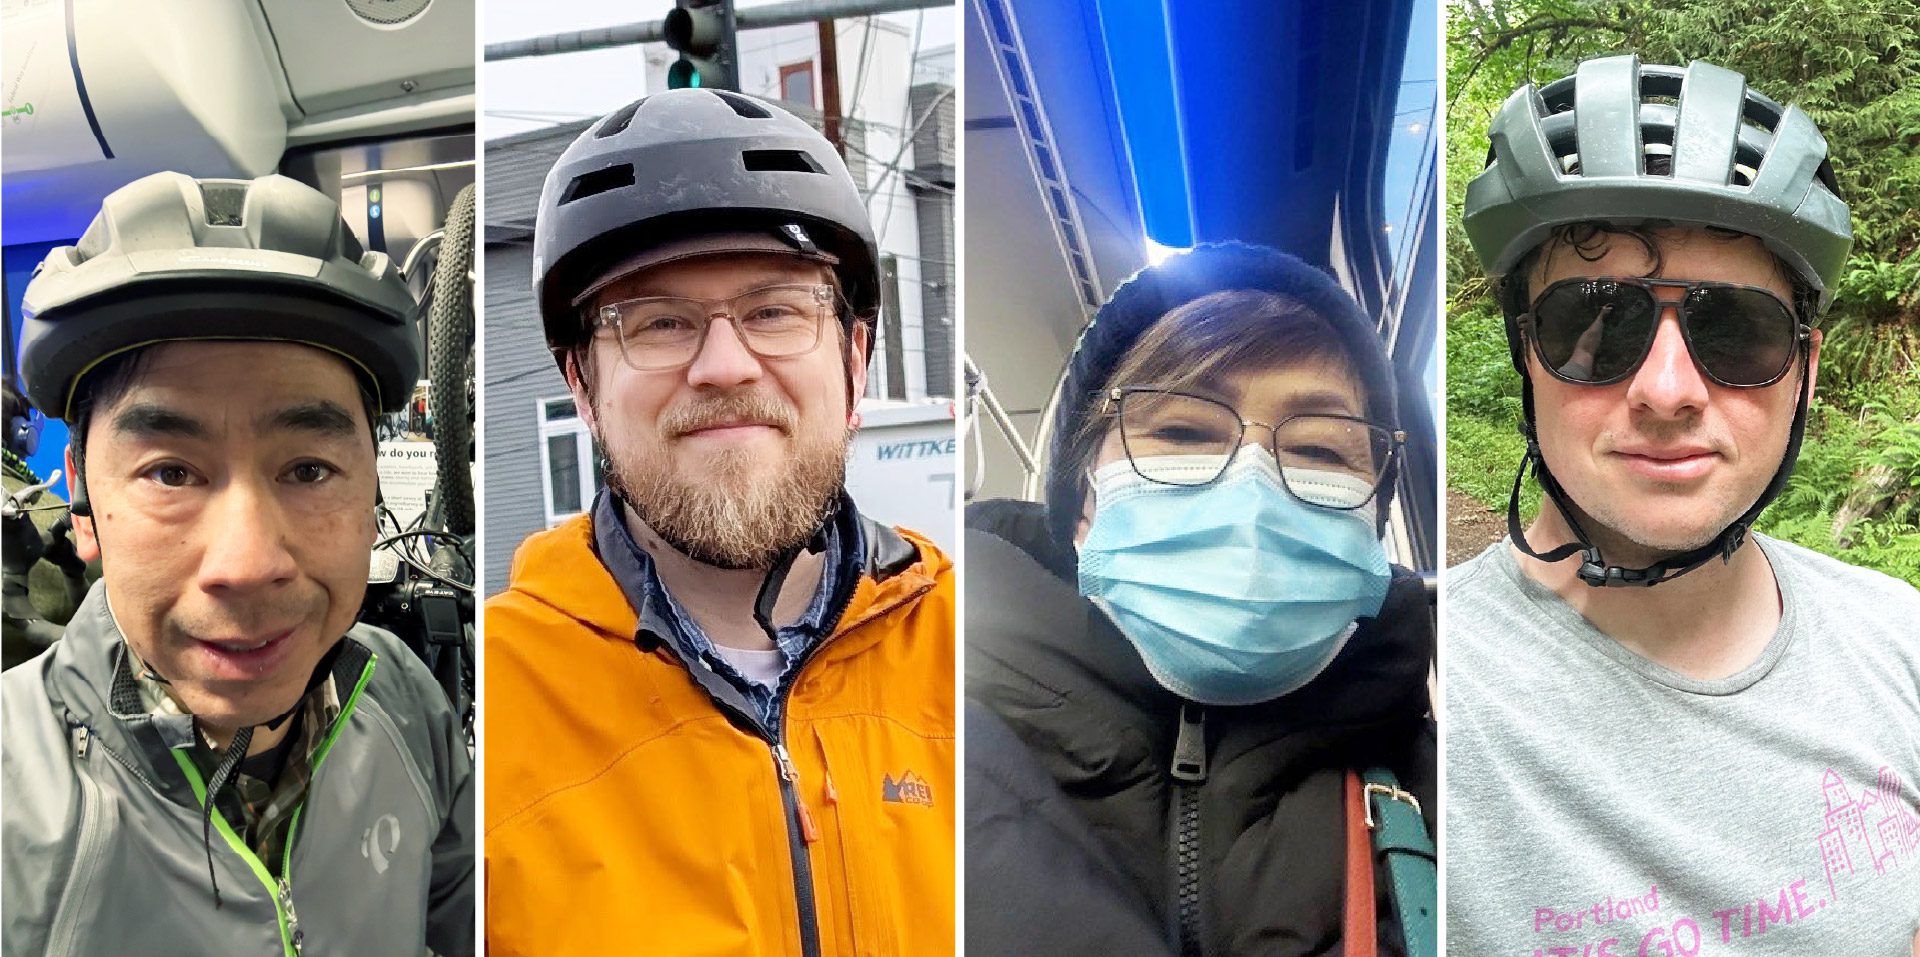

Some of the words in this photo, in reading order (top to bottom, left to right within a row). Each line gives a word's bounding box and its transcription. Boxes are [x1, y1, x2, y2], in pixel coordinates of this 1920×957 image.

[390, 448, 404, 457] do
[406, 450, 427, 460] you
[1534, 883, 1660, 933] Portland
[1638, 917, 1701, 957] GO
[1713, 879, 1827, 943] TIME.
